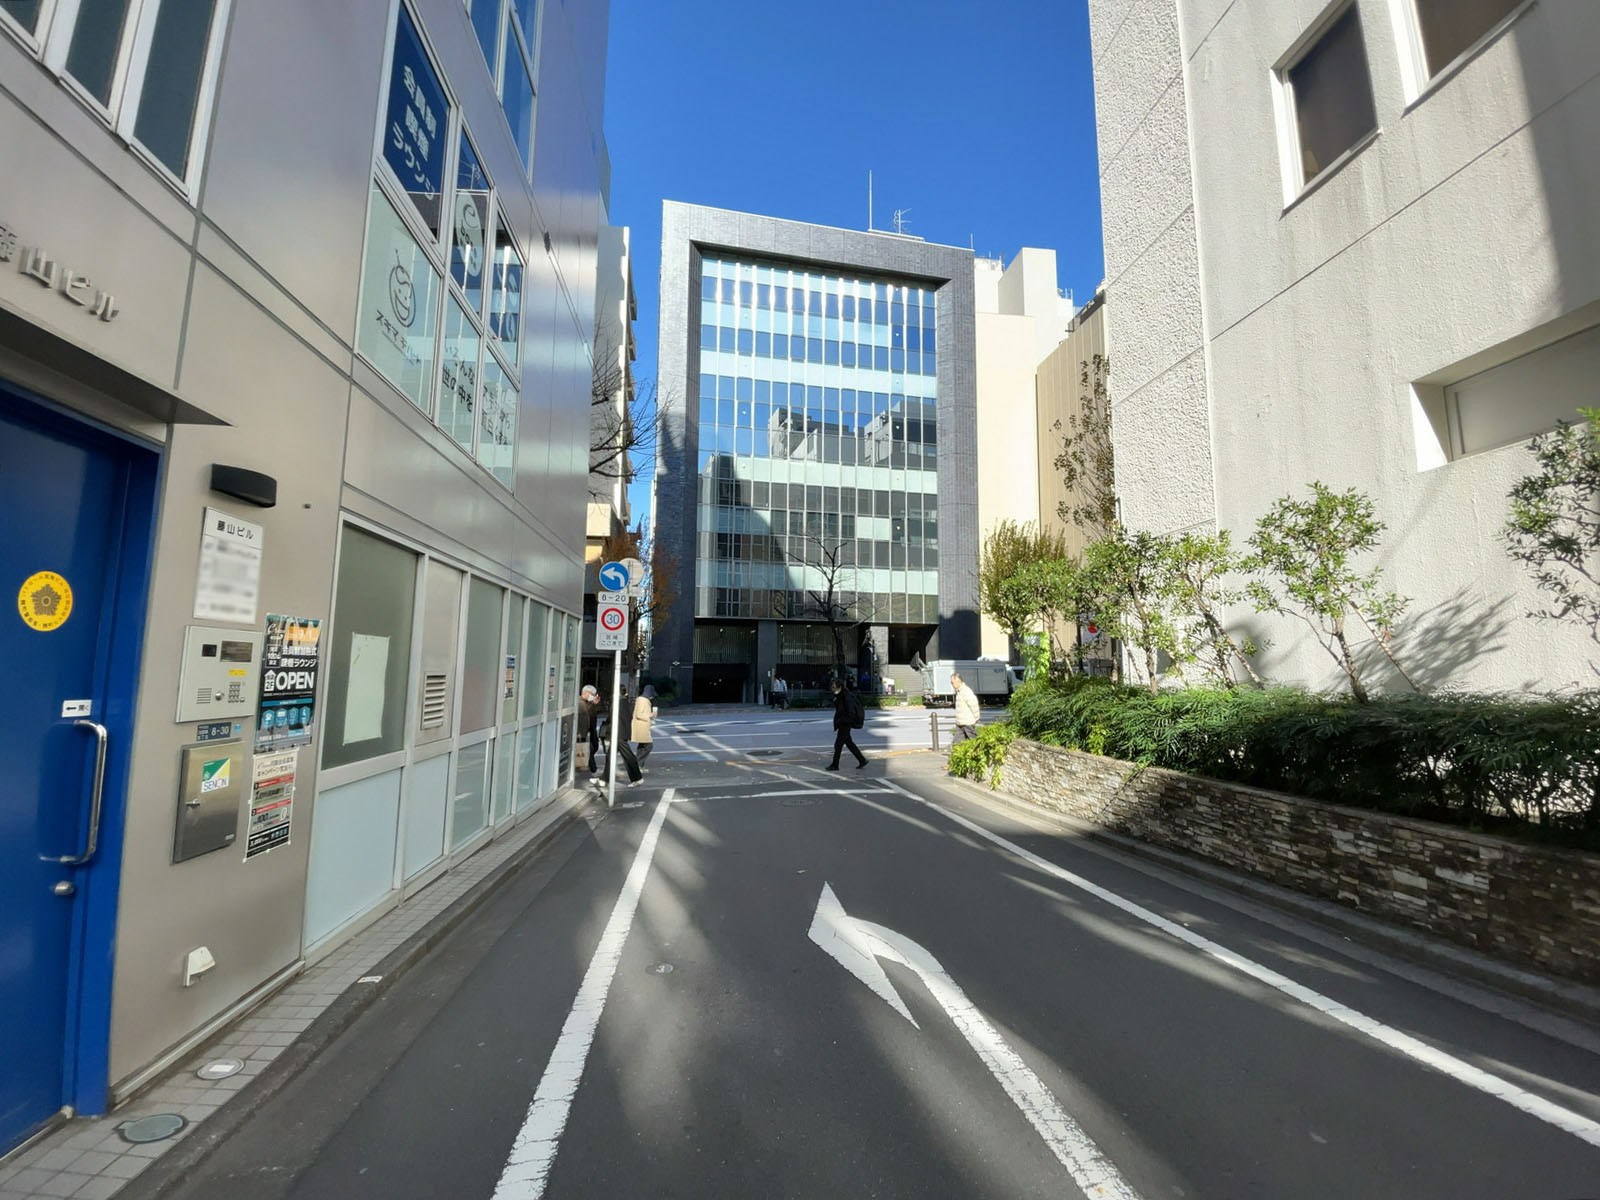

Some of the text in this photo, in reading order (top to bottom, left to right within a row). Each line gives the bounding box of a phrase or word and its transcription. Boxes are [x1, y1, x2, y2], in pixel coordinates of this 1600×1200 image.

[392, 121, 436, 200] ラウンジ
[601, 593, 626, 603] 8-20
[606, 613, 620, 625] 30
[276, 671, 315, 690] OPEN
